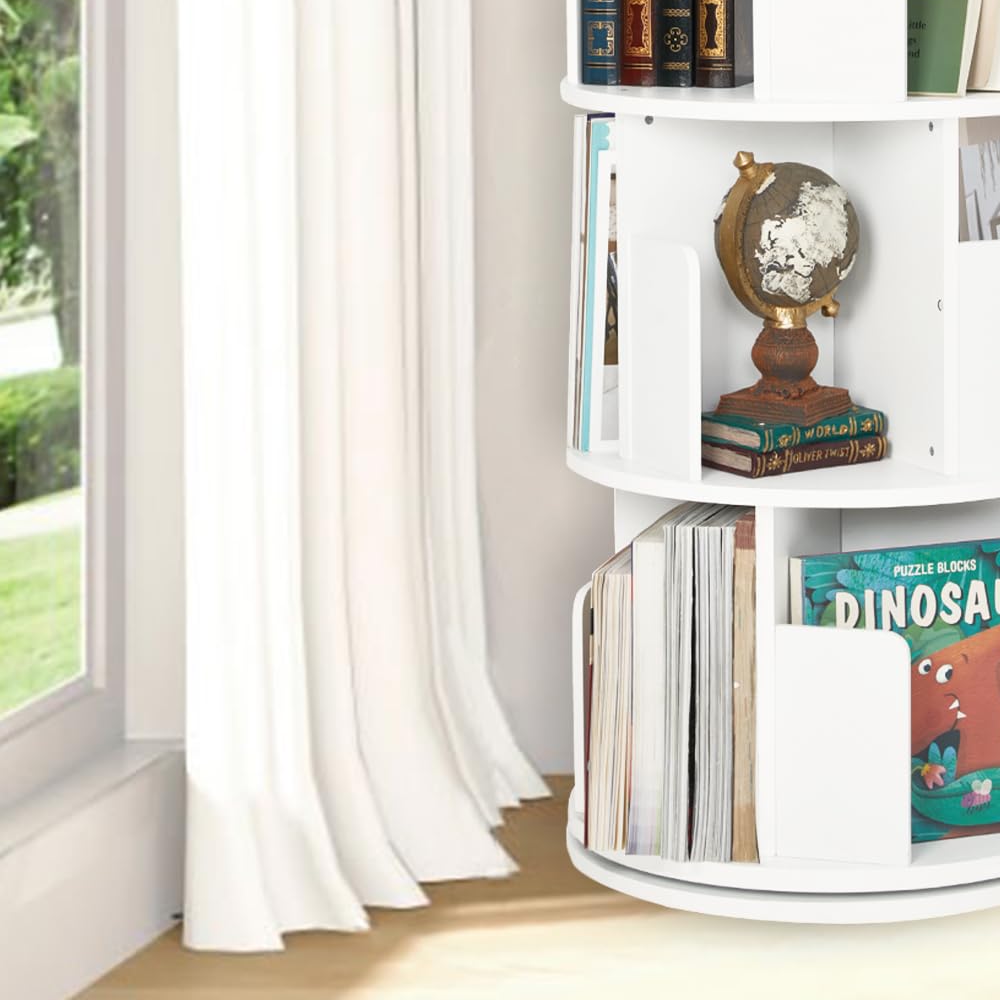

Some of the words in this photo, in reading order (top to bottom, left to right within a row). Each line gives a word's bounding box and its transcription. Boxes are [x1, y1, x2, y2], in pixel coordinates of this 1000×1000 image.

[908, 20, 926, 30] ittle
[804, 423, 848, 440] WORLD
[792, 449, 823, 464] OLIVER
[824, 446, 851, 459] TWIST
[893, 562, 934, 578] PUZZLE
[937, 558, 977, 574] BLOCKS
